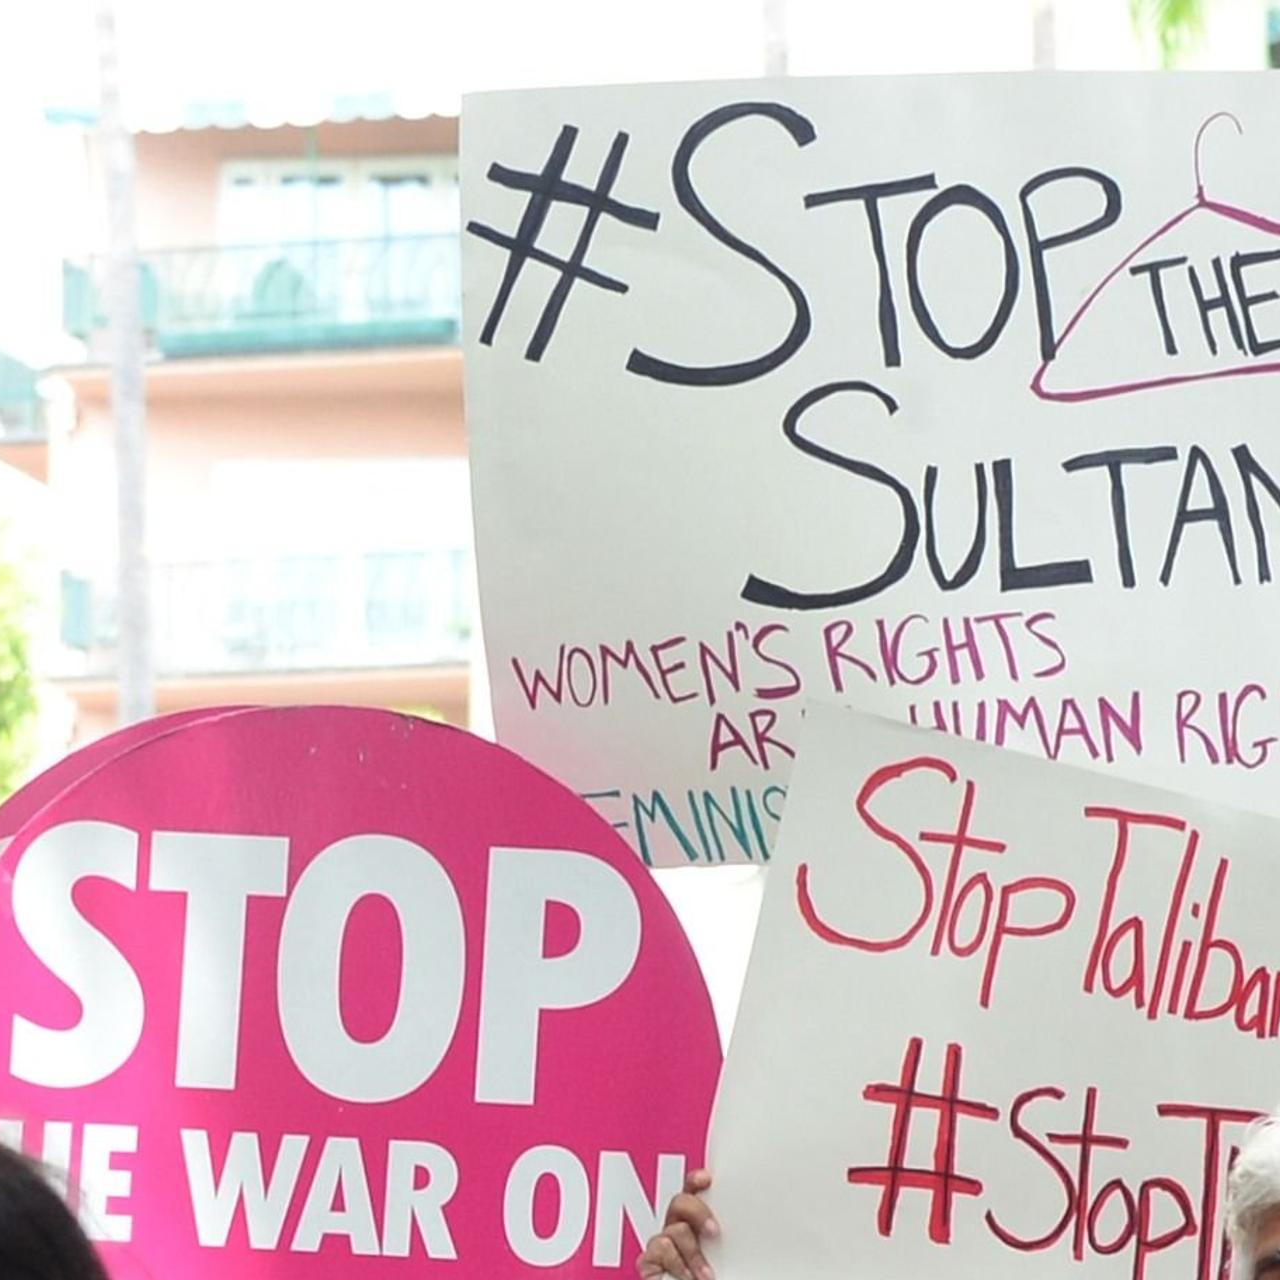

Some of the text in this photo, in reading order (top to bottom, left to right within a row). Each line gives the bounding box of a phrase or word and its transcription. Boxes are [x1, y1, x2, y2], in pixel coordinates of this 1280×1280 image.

[512, 612, 1066, 711] WOMEN'S RIGHTS
[710, 708, 805, 770] AR
[796, 756, 1074, 1009] Stop
[8, 820, 642, 1107] STOP
[181, 1128, 459, 1261] WAR
[503, 1144, 686, 1268] ON
